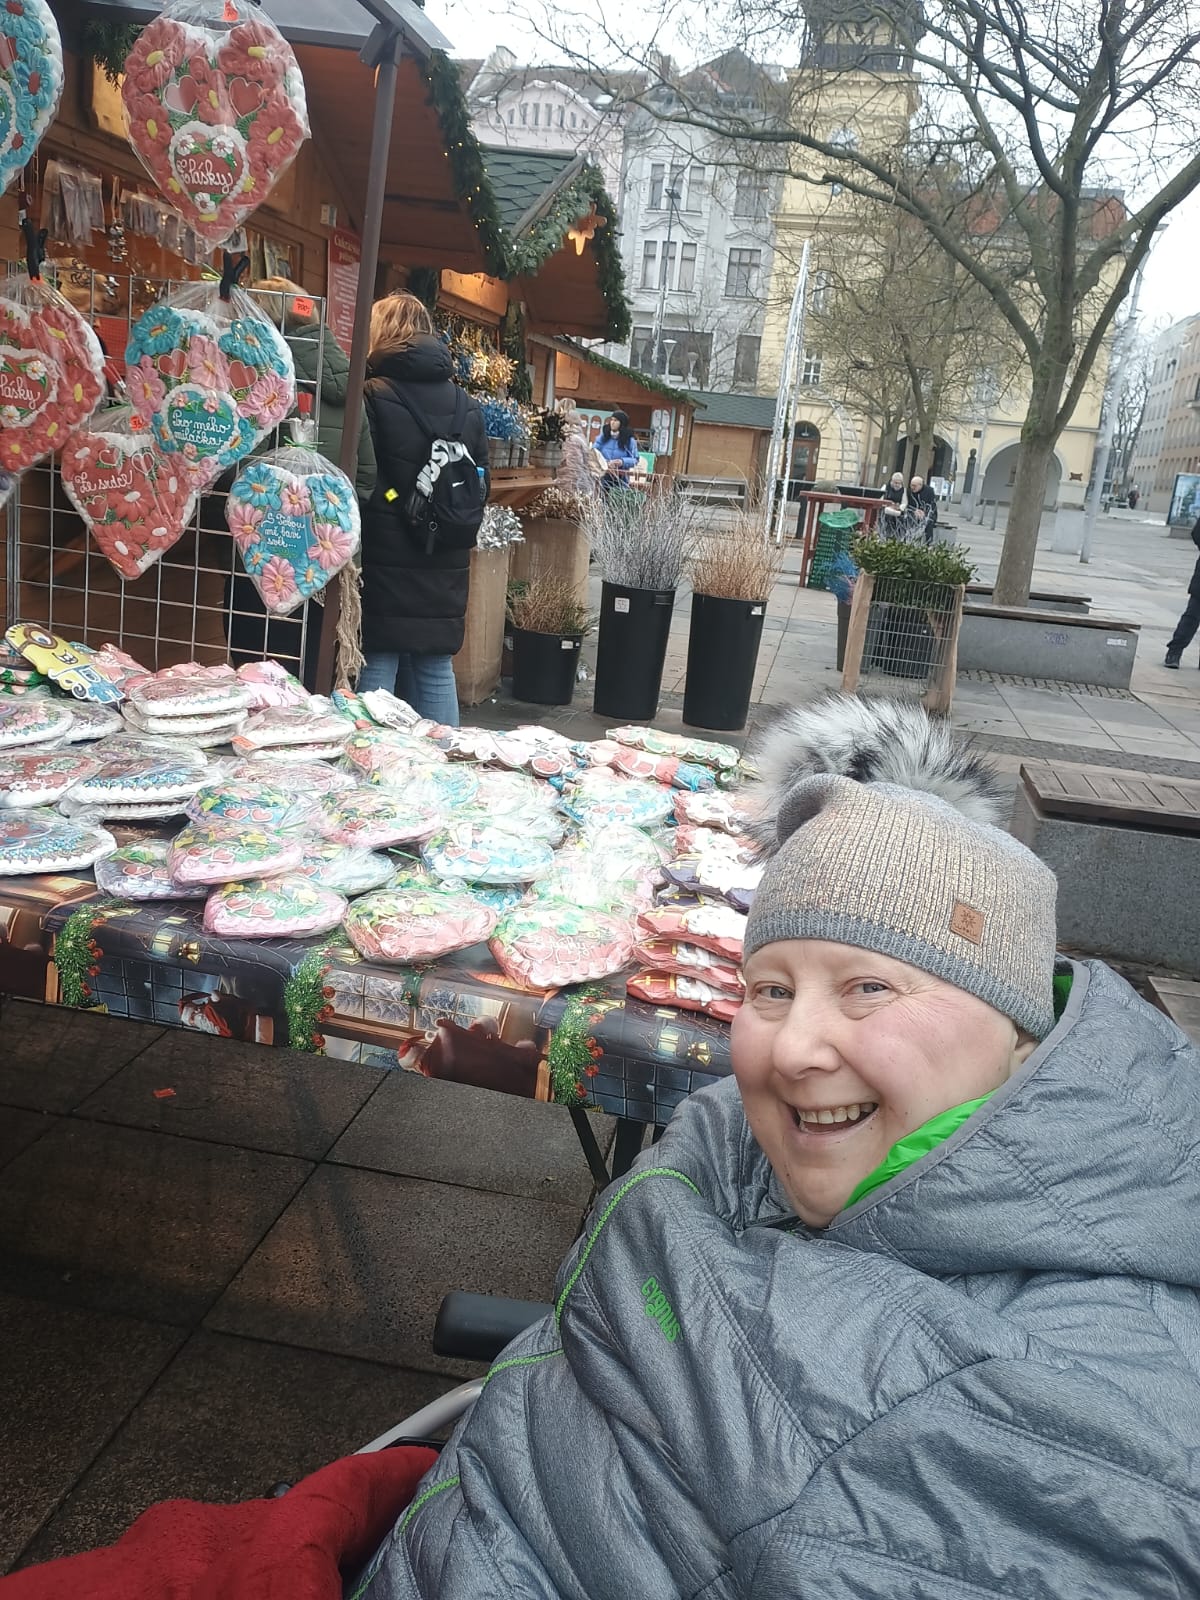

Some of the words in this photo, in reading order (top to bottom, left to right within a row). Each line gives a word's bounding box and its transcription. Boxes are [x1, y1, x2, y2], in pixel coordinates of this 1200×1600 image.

[188, 158, 233, 194] lásky
[172, 409, 193, 427] Pro
[641, 1276, 684, 1343] cygnus
